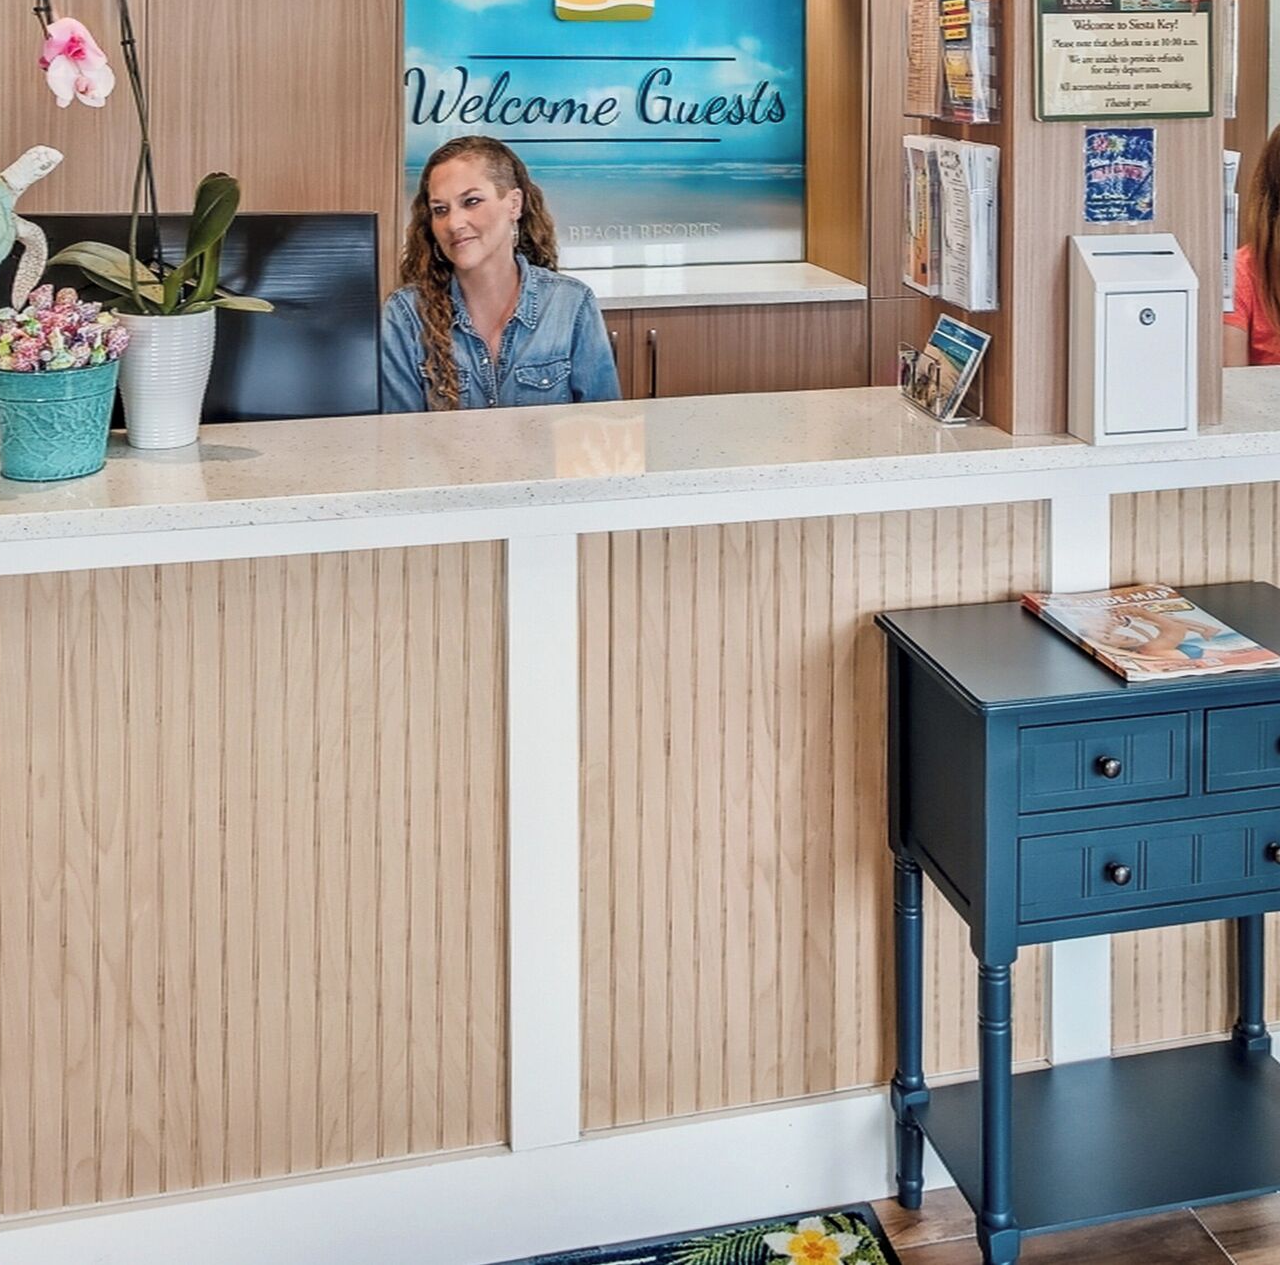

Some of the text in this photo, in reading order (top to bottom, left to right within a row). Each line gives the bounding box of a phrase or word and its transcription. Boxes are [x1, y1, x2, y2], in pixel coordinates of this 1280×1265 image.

[1072, 18, 1180, 33] Welcome to Siesta Key!
[1052, 38, 1075, 48] Please
[1075, 40, 1093, 48] note
[1093, 38, 1109, 48] that
[1108, 37, 1130, 48] check
[1130, 39, 1144, 47] out
[1144, 38, 1152, 47] is
[1152, 39, 1161, 47] at
[1182, 39, 1200, 47] a.m.
[1068, 53, 1185, 65] We are unable to provide refunds
[1091, 64, 1163, 77] for early departures.
[1059, 81, 1071, 92] All
[1071, 80, 1131, 91] accommodations
[1132, 82, 1145, 91] are
[404, 65, 788, 126] Welcome Guests
[1104, 97, 1152, 110] Thank you!
[567, 222, 722, 242] BEACH RESORTS
